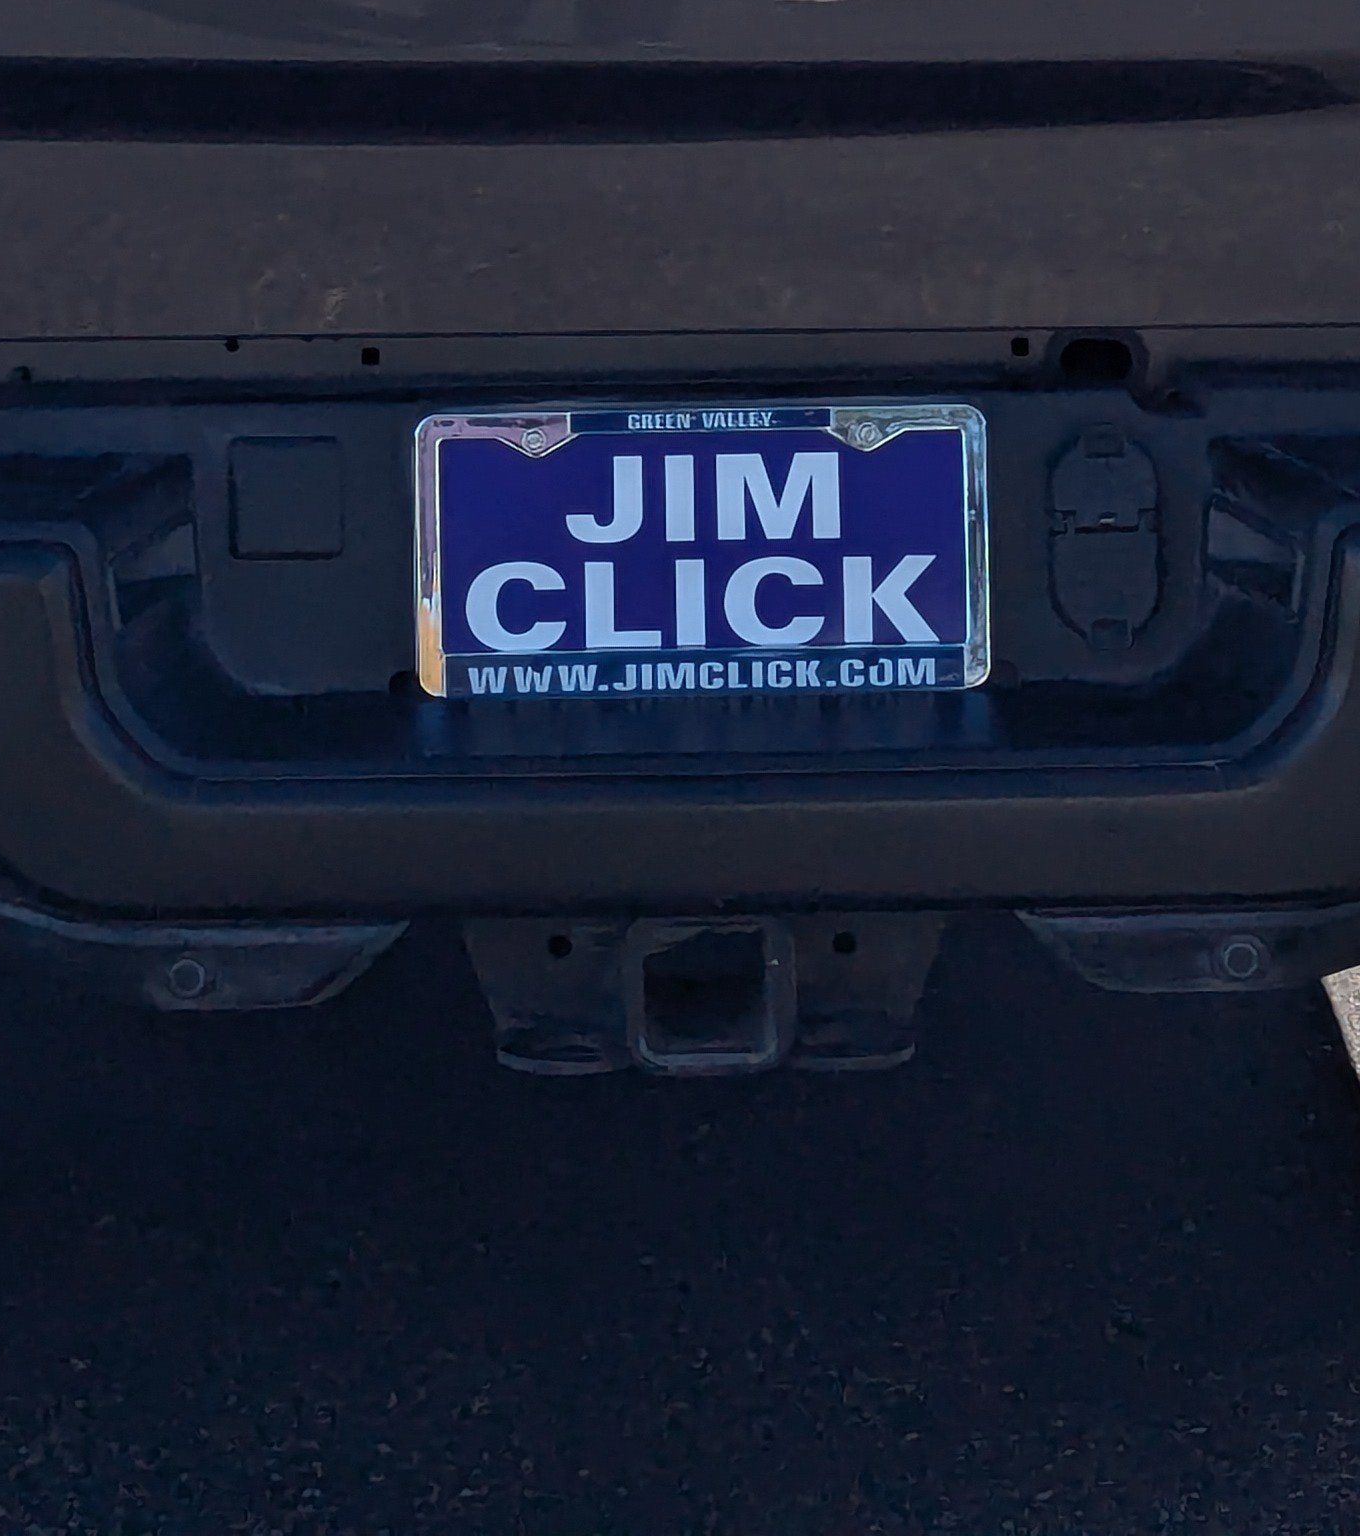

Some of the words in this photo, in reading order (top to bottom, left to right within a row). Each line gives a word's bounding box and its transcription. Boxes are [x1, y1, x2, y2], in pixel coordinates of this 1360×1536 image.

[627, 413, 691, 430] GREEN
[701, 411, 773, 428] VALLEY
[566, 452, 840, 543] JIM
[466, 555, 939, 651] CLICK
[468, 658, 936, 694] WWW.JIMCLICK.COM
